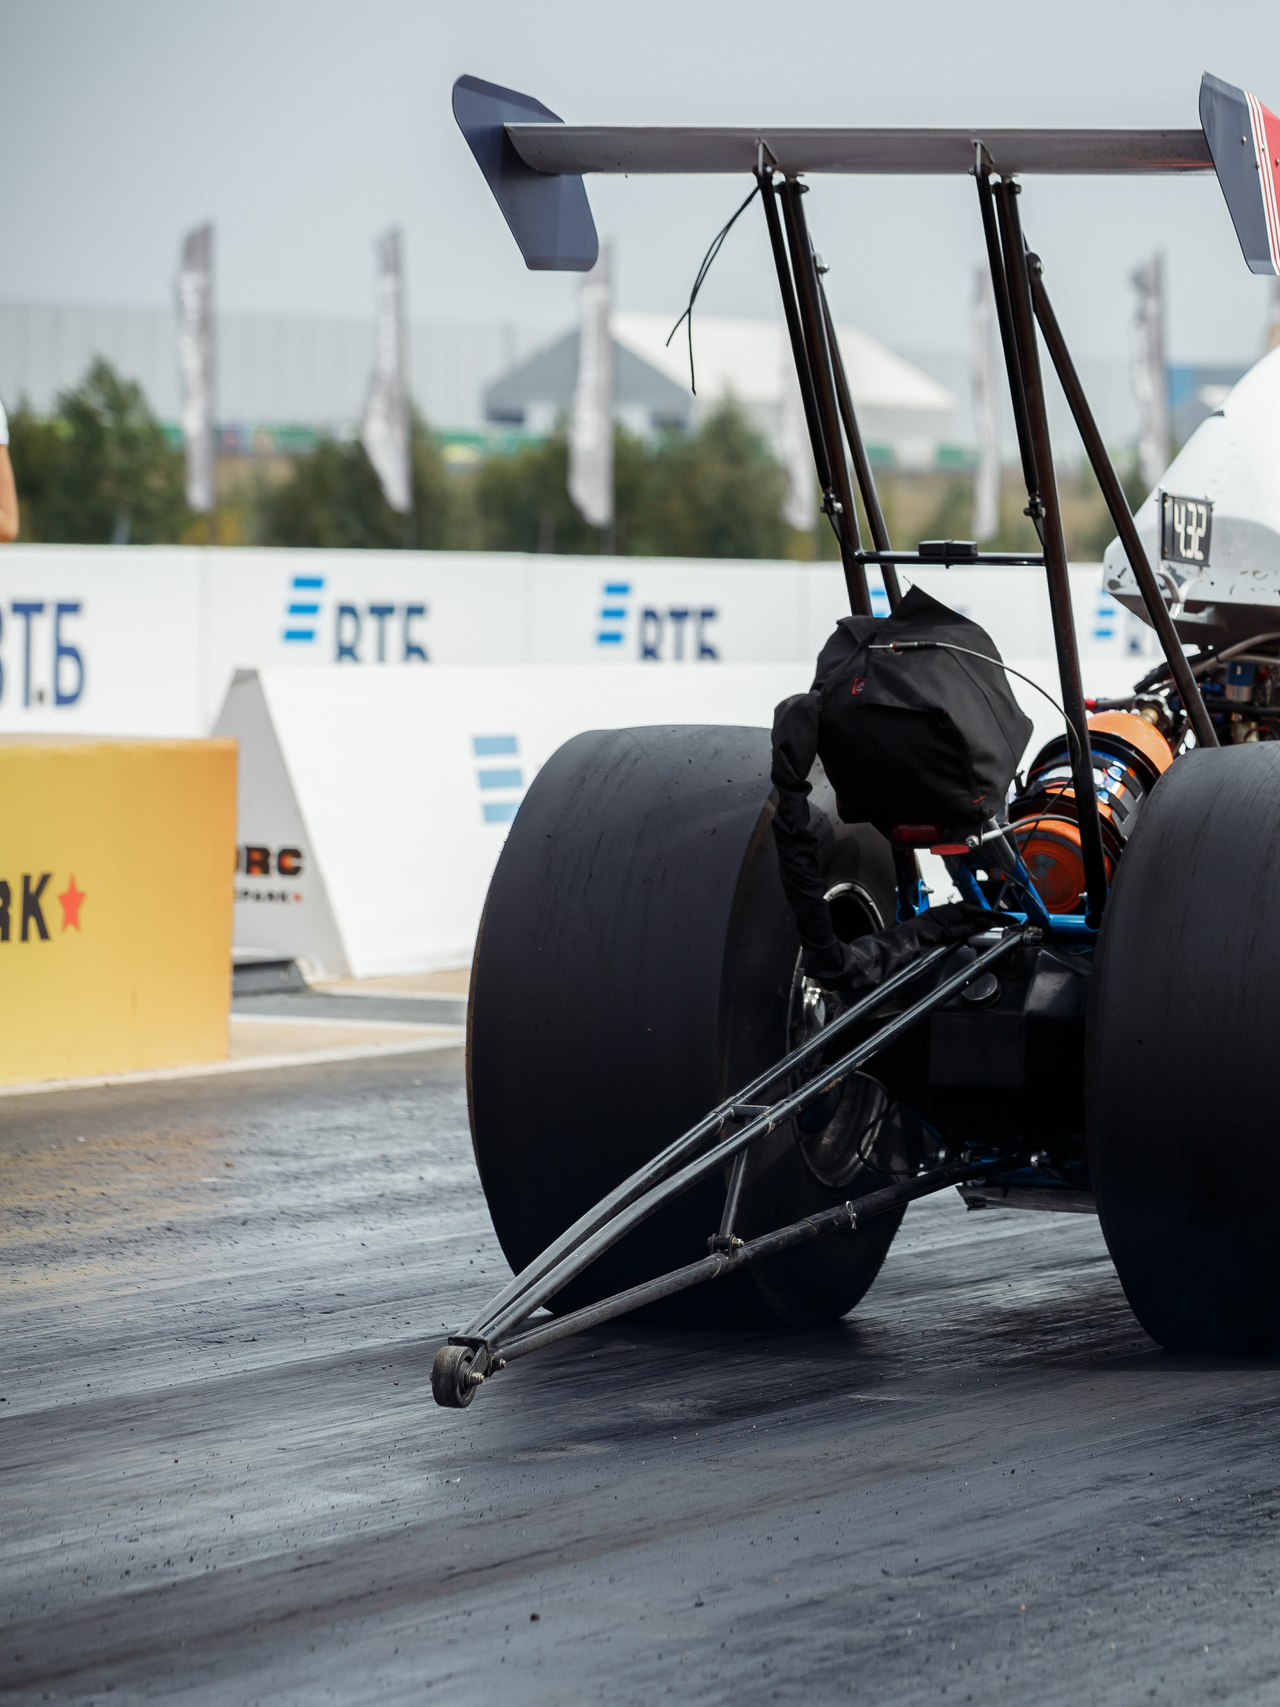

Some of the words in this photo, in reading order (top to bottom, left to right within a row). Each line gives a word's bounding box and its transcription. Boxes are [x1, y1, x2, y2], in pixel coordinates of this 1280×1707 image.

[1173, 502, 1207, 561] 432
[0, 602, 85, 707] ТБ
[236, 846, 302, 876] RC
